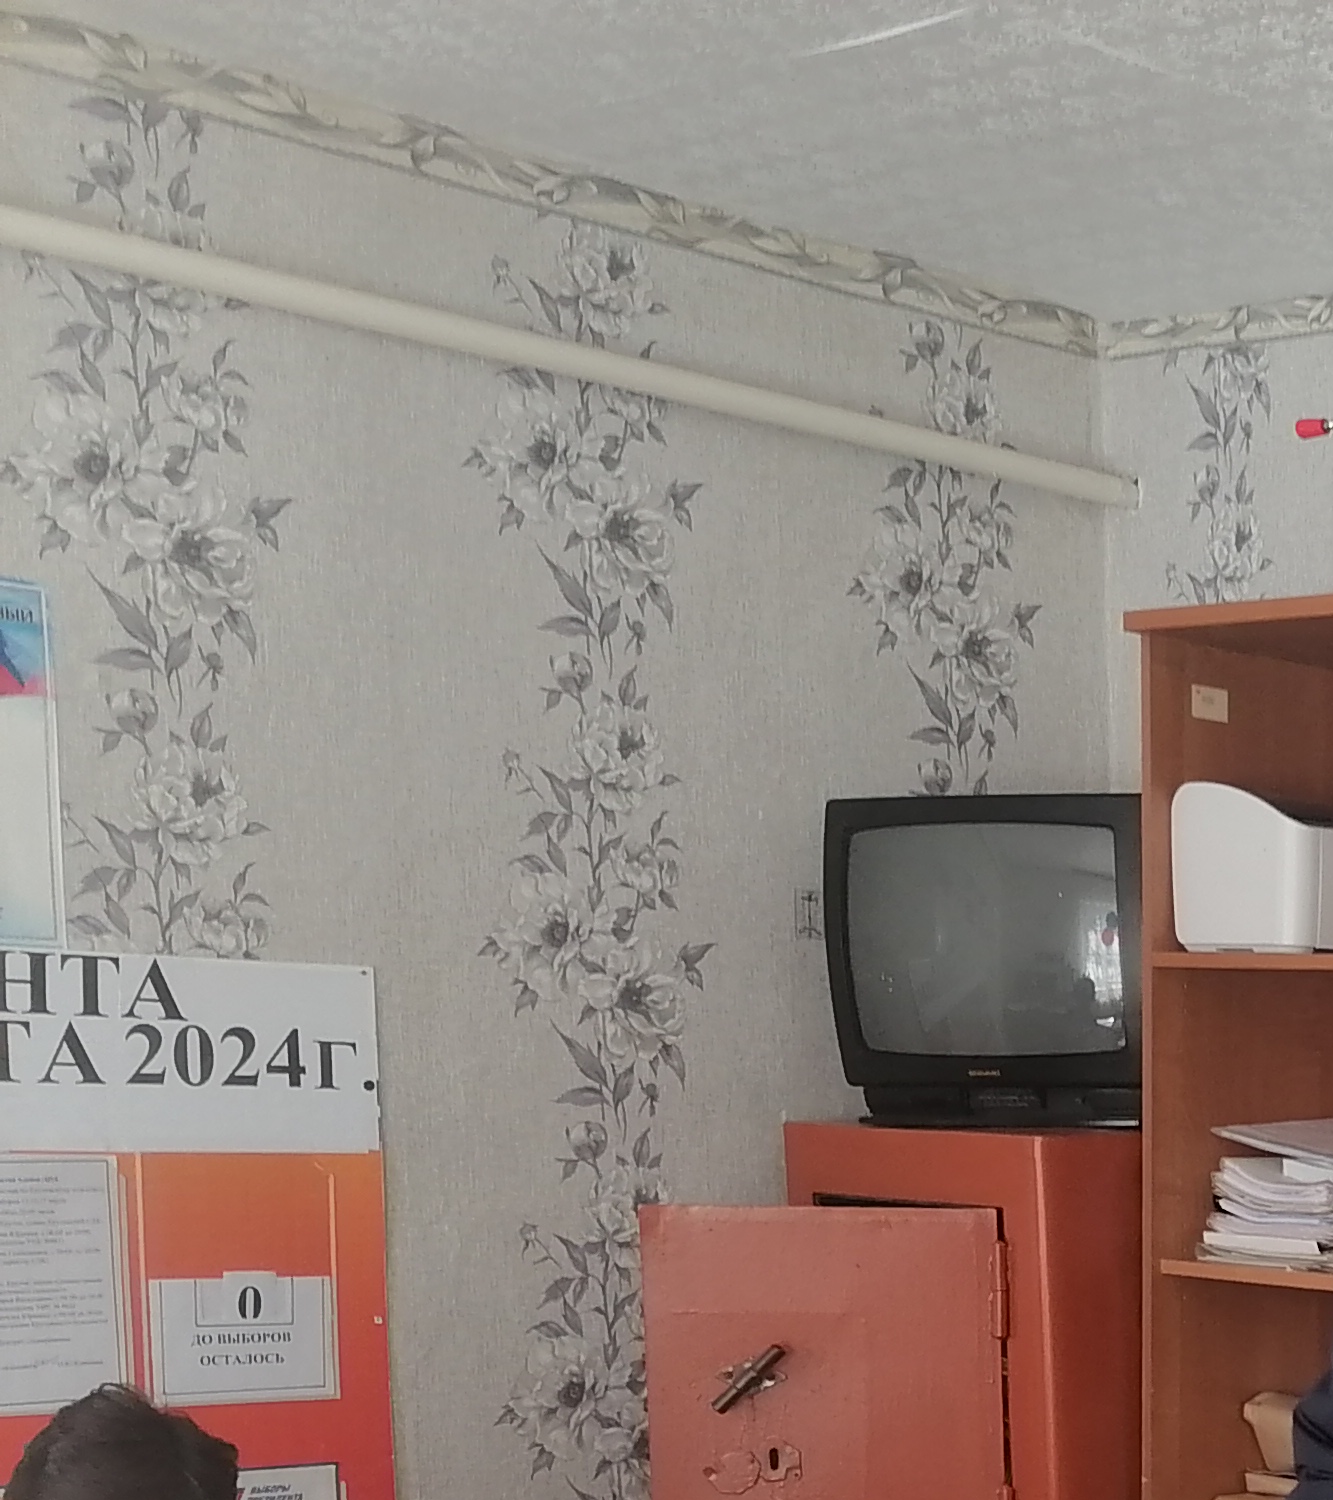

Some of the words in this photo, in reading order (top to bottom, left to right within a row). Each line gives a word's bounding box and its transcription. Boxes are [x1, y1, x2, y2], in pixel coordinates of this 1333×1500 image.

[238, 1285, 262, 1320] 0
[190, 1332, 213, 1347] ДО
[217, 1331, 292, 1345] ВЫБОРОВ
[199, 1352, 285, 1367] ОСТАЛОСЬ
